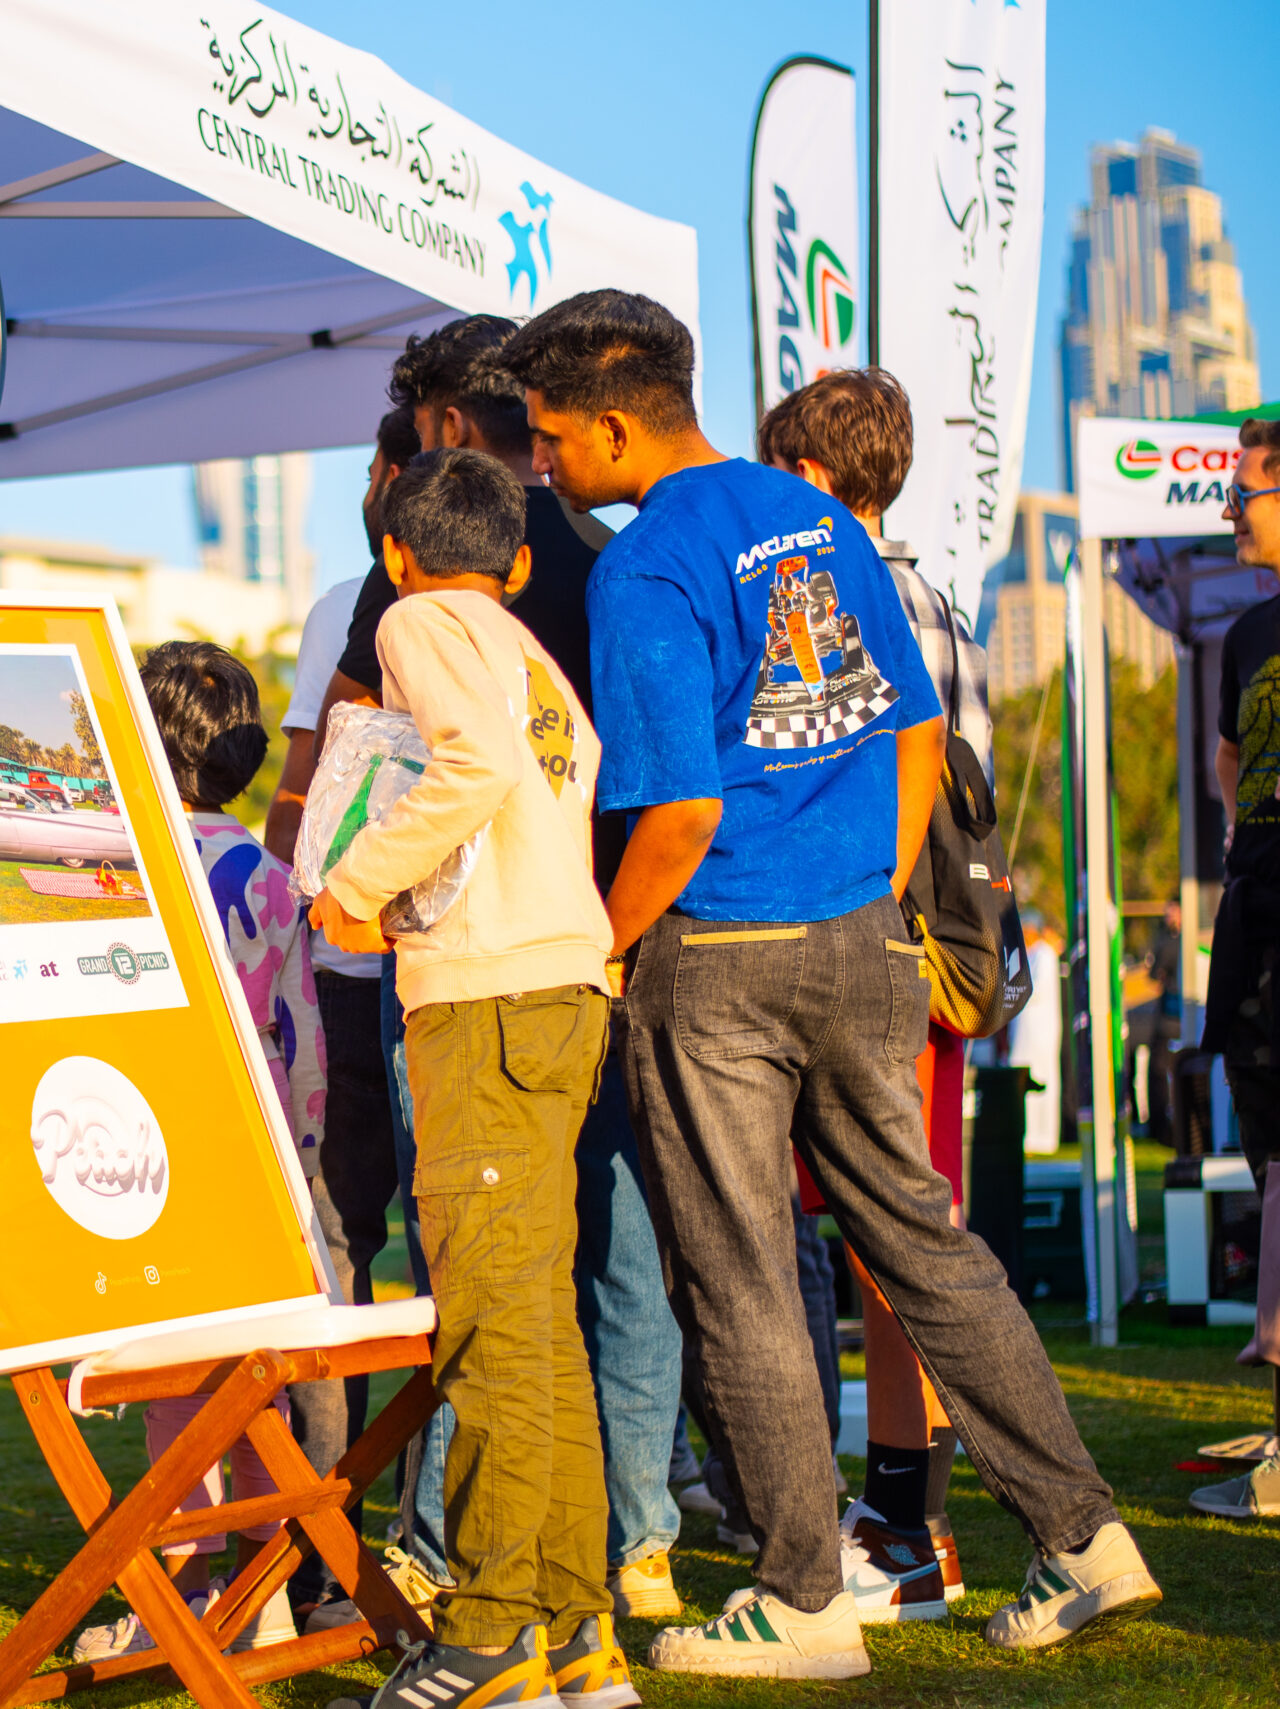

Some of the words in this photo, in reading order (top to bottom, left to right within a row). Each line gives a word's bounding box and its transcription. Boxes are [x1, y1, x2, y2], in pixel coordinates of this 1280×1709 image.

[200, 17, 298, 118] المركزية
[300, 63, 404, 168] التجارية
[198, 107, 297, 189] CENTRAL
[297, 154, 394, 234] TRADING
[397, 202, 486, 278] COMPANY
[407, 122, 481, 212] الشركة
[774, 182, 804, 400] MAG
[735, 528, 833, 575] McLaren
[39, 960, 60, 977] at
[79, 957, 108, 973] GRAND
[114, 955, 135, 975] 12
[139, 953, 168, 969] PICNIC
